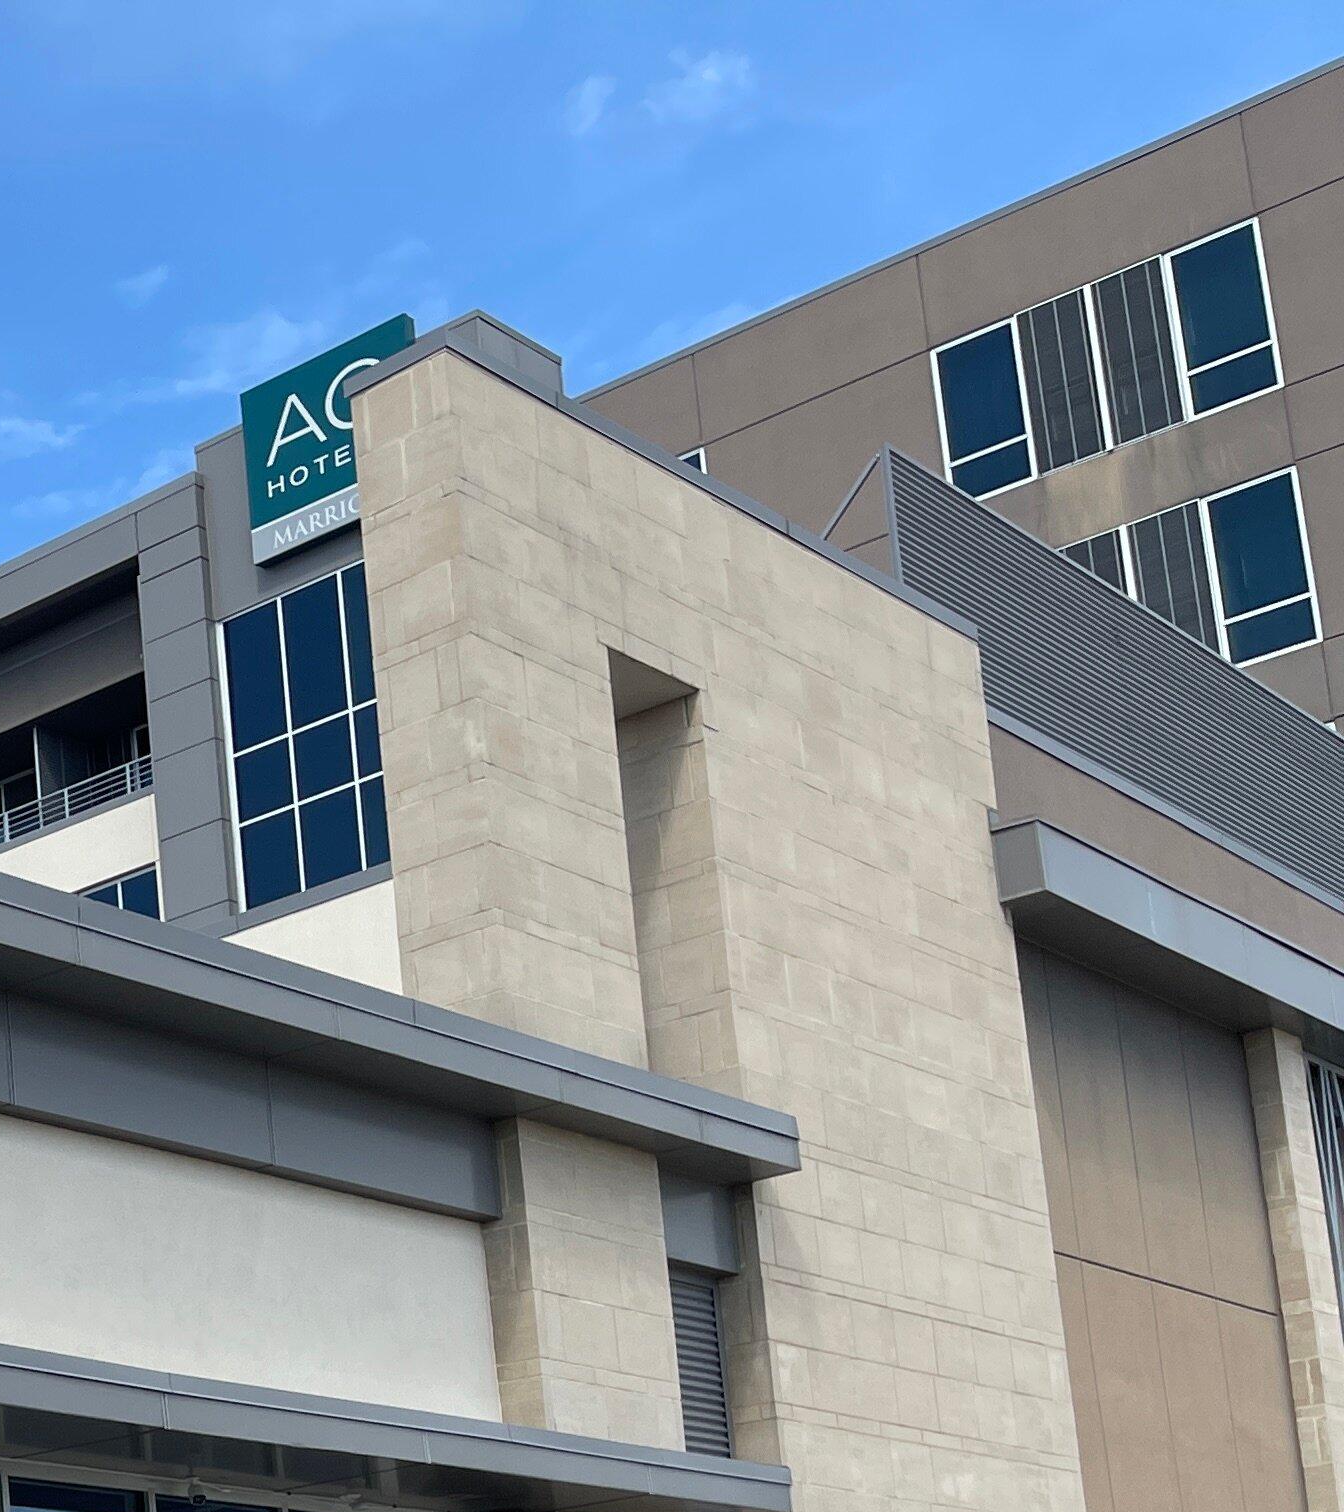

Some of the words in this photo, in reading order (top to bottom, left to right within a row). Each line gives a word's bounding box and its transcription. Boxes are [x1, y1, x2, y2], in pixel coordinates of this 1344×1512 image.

[266, 357, 380, 468] AC
[266, 444, 352, 498] HOTE
[273, 493, 361, 549] MARRIO
